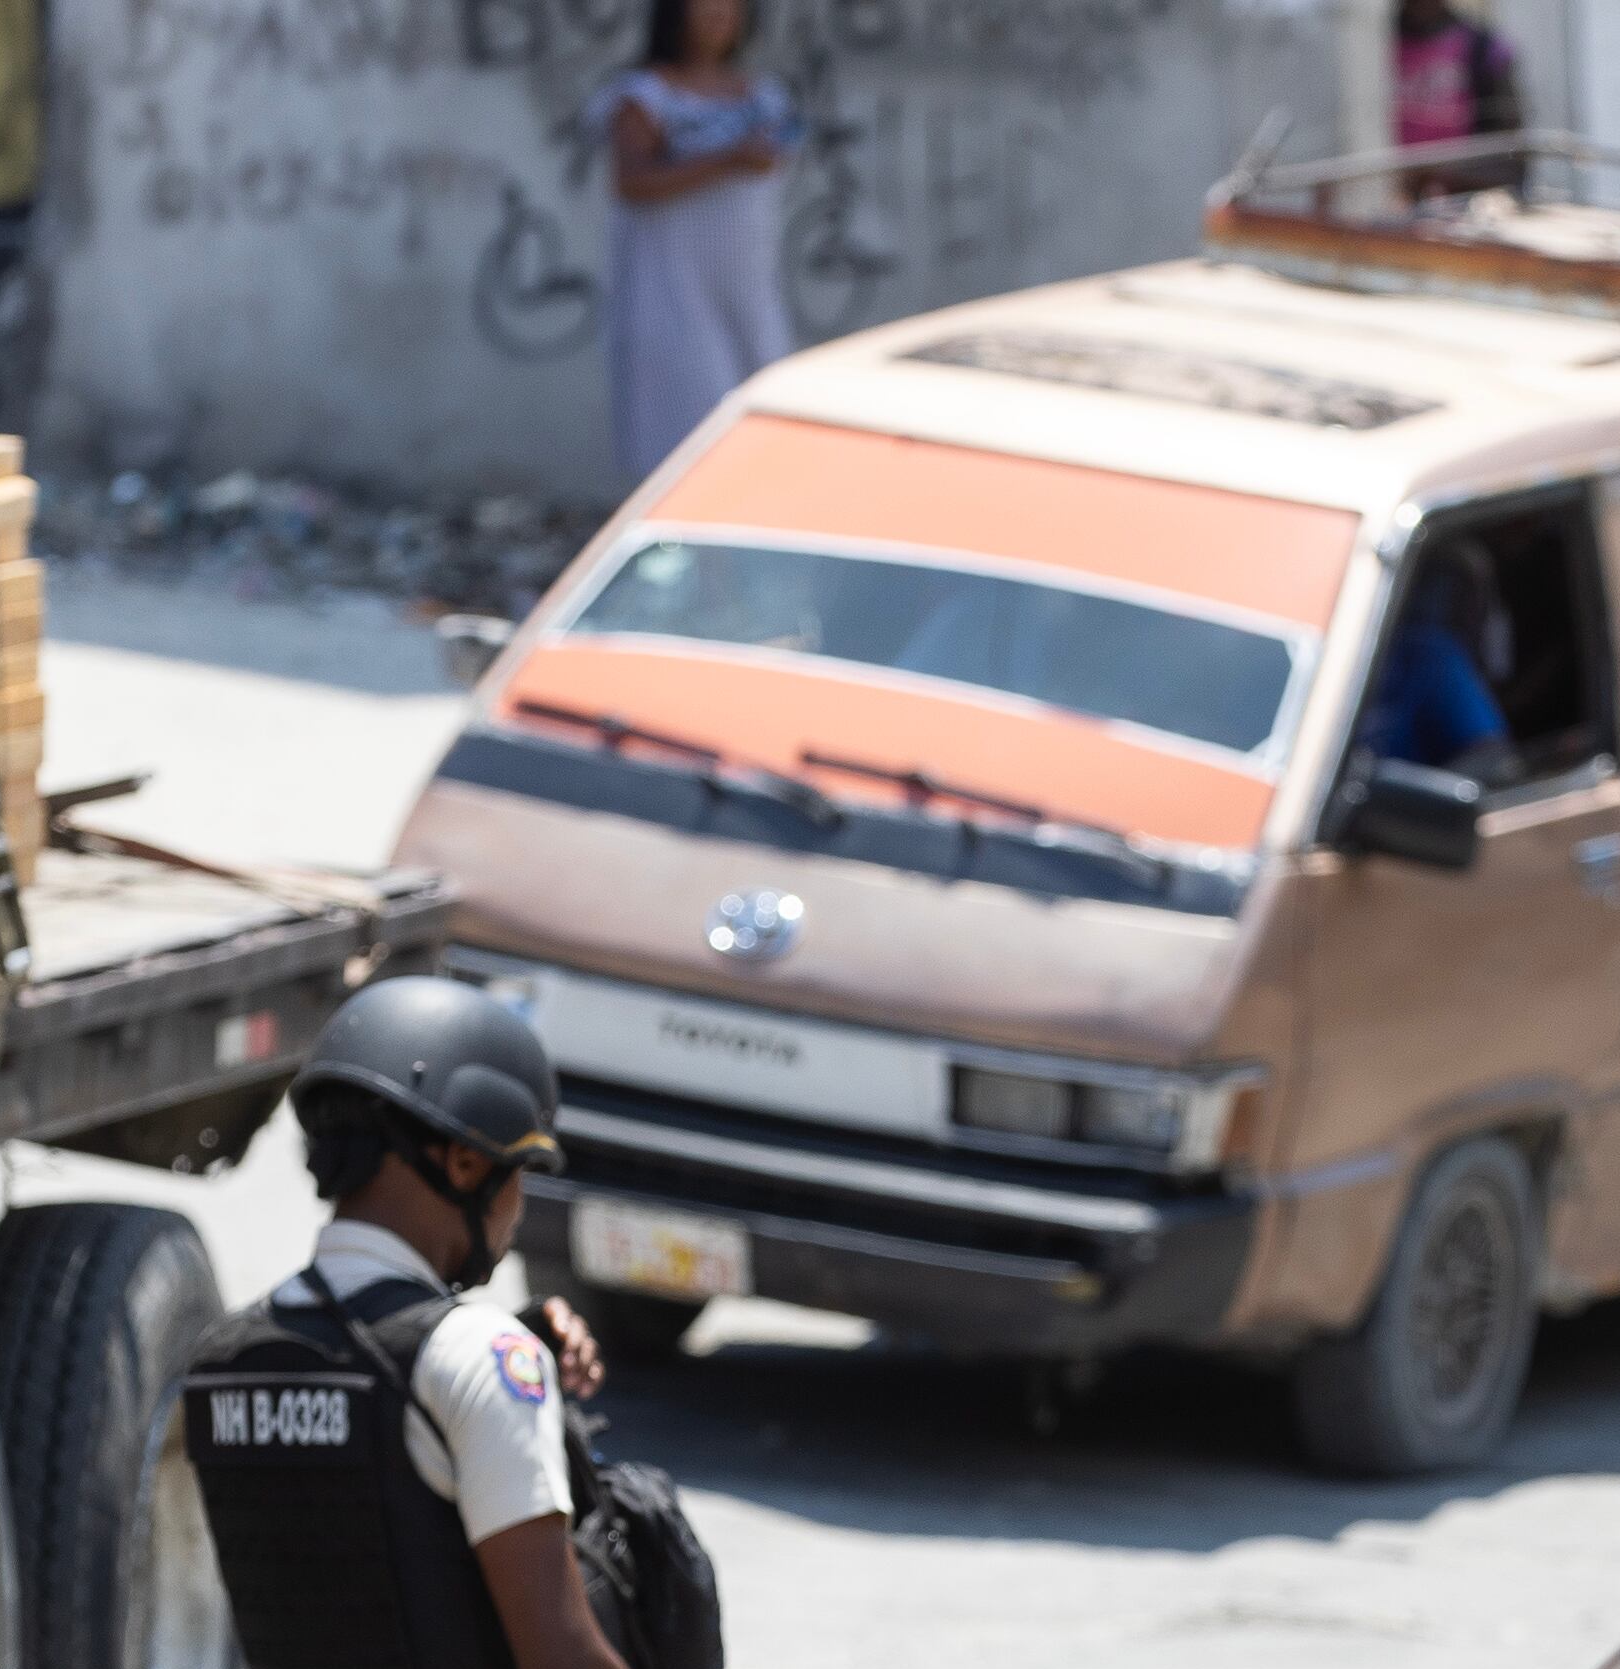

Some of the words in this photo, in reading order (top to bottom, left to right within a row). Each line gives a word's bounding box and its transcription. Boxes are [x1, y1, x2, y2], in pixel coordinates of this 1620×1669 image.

[657, 1013, 805, 1068] TOYOTA
[209, 1390, 248, 1446] NH
[252, 1390, 351, 1446] B-0328
